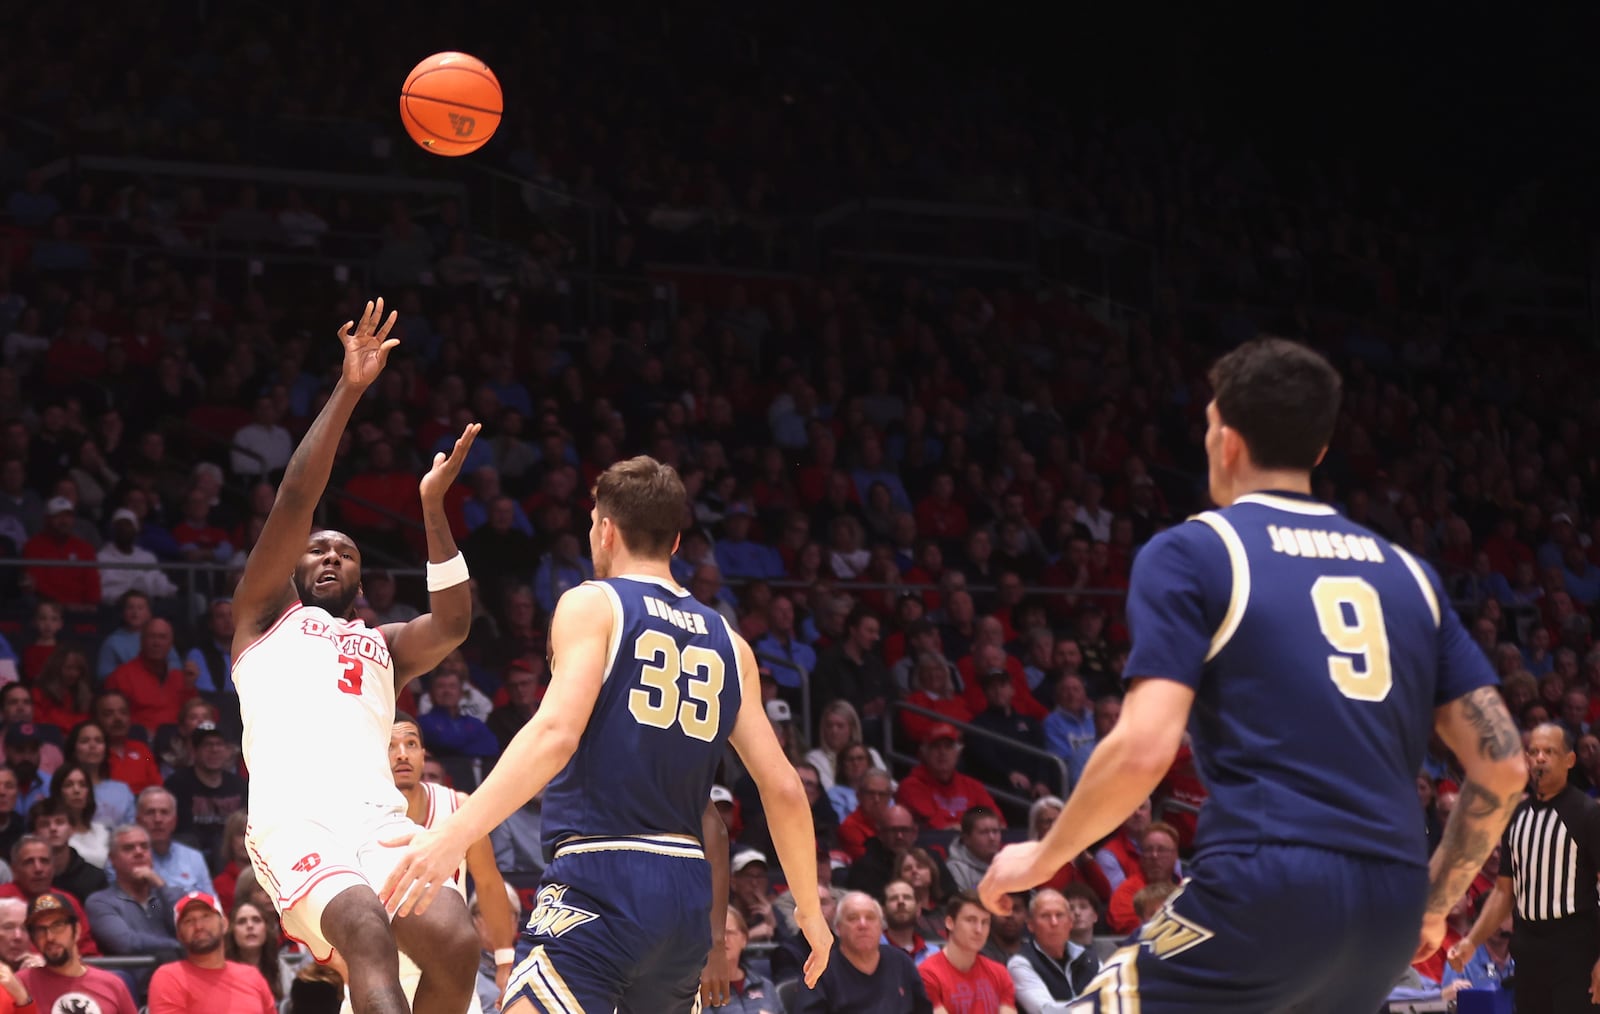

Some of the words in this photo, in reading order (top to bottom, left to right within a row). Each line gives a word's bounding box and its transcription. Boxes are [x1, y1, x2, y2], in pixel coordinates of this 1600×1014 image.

[1267, 525, 1385, 563] JOHNSON
[338, 654, 363, 695] 3
[1310, 575, 1393, 702] 9
[628, 629, 725, 743] 33
